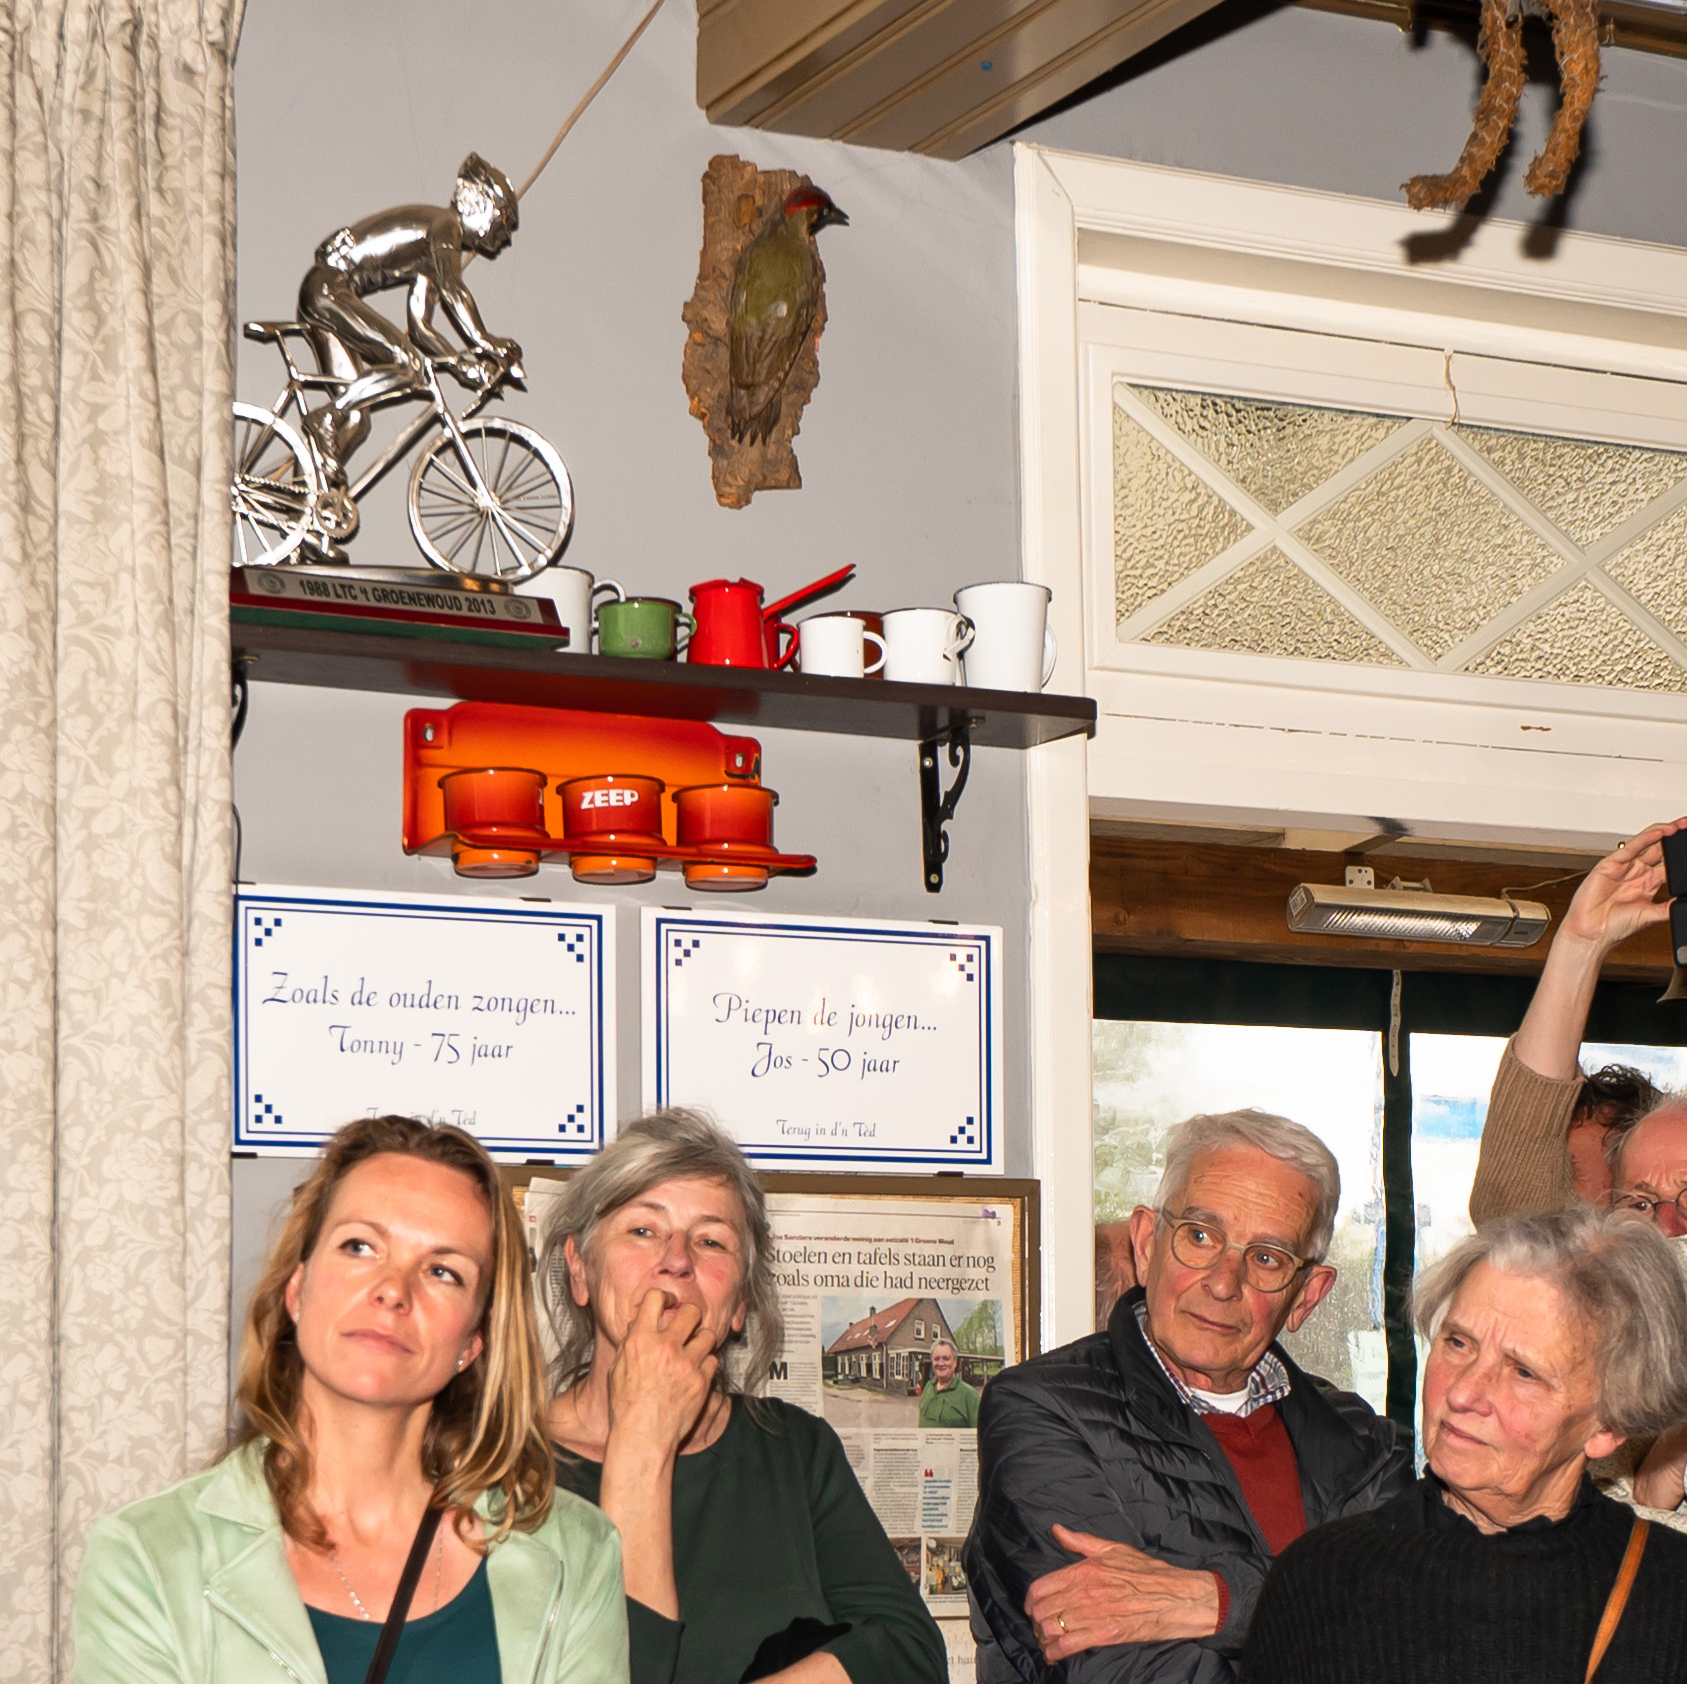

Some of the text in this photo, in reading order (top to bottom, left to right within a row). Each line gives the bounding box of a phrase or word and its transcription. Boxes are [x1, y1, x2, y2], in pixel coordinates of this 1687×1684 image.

[299, 579, 331, 599] 1988
[332, 582, 358, 601] LTC
[372, 586, 463, 613] GROENEWOUD
[466, 597, 497, 616] 2013
[580, 788, 640, 810] ZEEP
[261, 971, 577, 1026] Zoals de ouden zongen...
[712, 992, 938, 1041] Piepen de jongen...
[328, 1024, 405, 1066] Tonny
[431, 1032, 461, 1064] 75
[470, 1036, 514, 1066] jaar
[751, 1042, 793, 1078] Jos
[817, 1048, 852, 1078] 50
[861, 1051, 900, 1081] jaar
[776, 1119, 811, 1141] Terug
[816, 1123, 827, 1136] in
[830, 1121, 849, 1138] d'n
[832, 1250, 852, 1266] en
[856, 1247, 901, 1267] tafels
[903, 1251, 946, 1268] staan
[949, 1254, 963, 1269] er
[966, 1254, 997, 1273] nog
[814, 1273, 850, 1288] oma
[853, 1270, 880, 1290] die
[883, 1270, 914, 1290] had
[916, 1274, 991, 1296] neergezet
